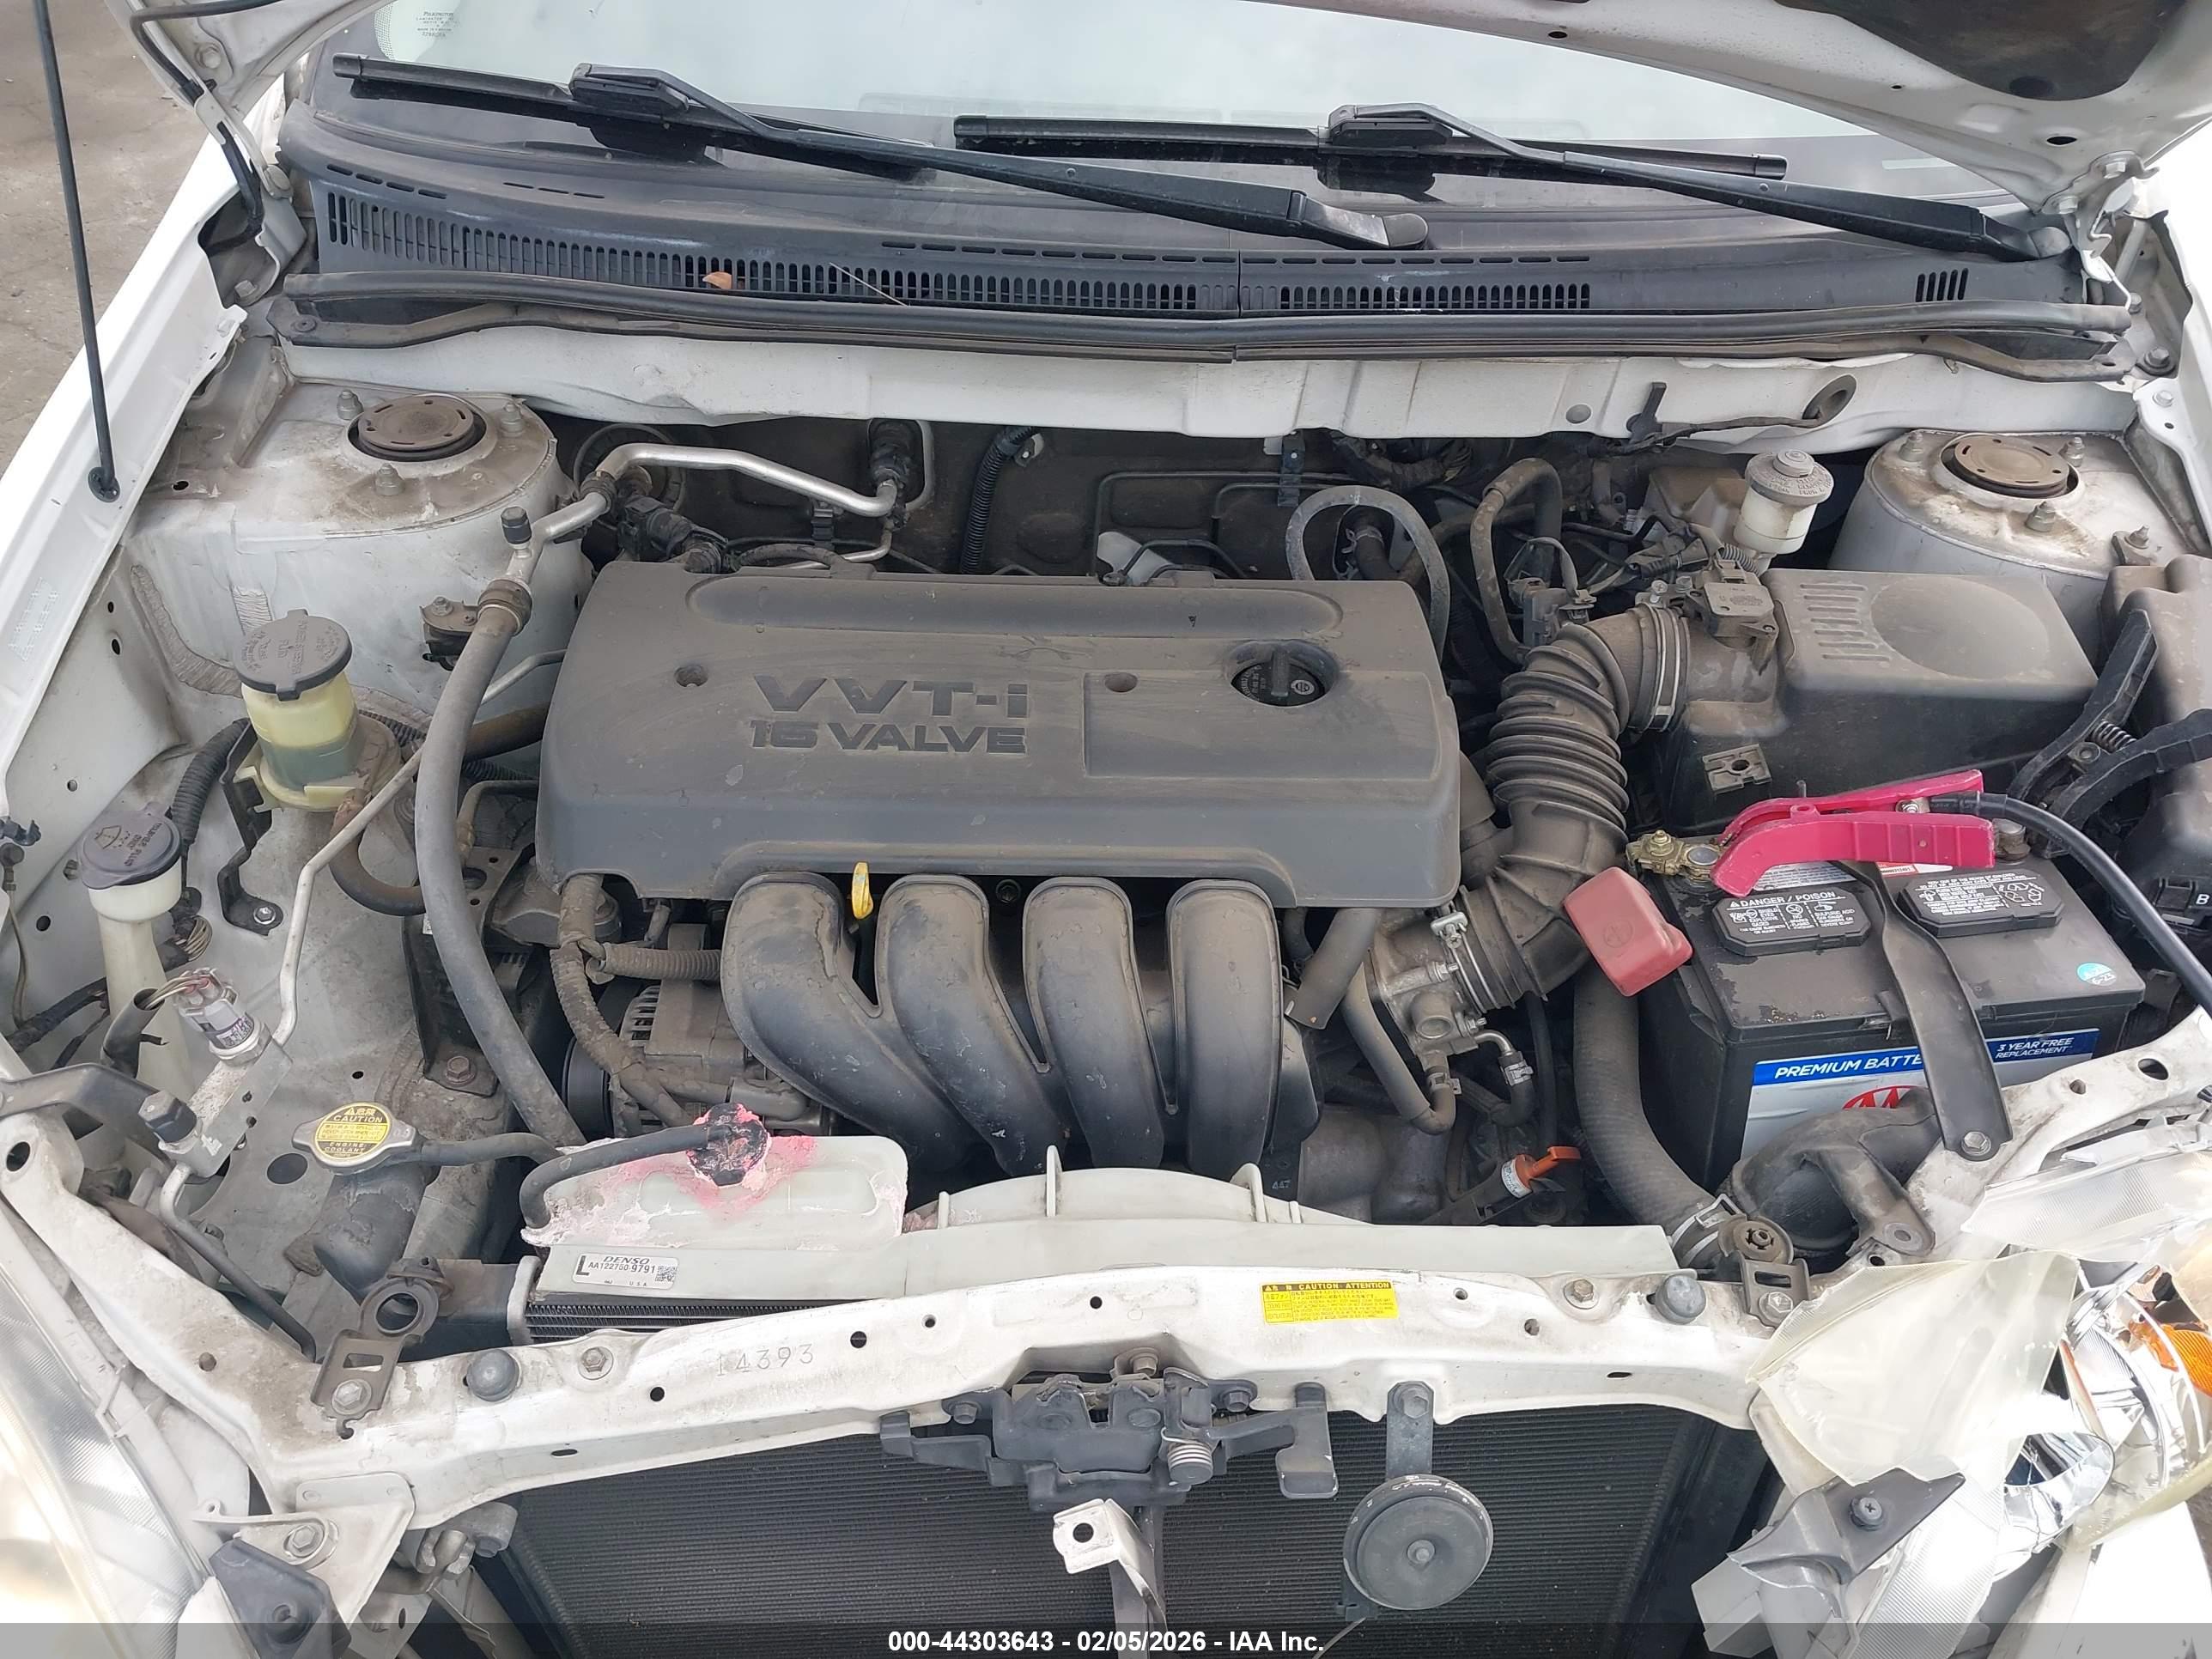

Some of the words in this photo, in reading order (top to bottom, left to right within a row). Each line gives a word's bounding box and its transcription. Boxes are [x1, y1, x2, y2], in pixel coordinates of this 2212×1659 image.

[754, 676, 1028, 719] VVT-i
[750, 720, 817, 749] 16
[828, 722, 1026, 754] VALVE
[1740, 896, 1785, 907] DANGER
[1796, 891, 1836, 902] POISON
[2196, 894, 2209, 905] B
[1995, 1046, 2069, 1059] REPLACEMENT
[1996, 1043, 2007, 1052] 3
[2007, 1041, 2040, 1051] YEAR
[2040, 1037, 2075, 1048] FREE
[1774, 1060, 1863, 1079] PREMIUM
[1863, 1054, 1923, 1070] BATTE
[576, 1255, 590, 1276] L
[603, 1256, 651, 1265] DENSO
[717, 1344, 813, 1376] 14393
